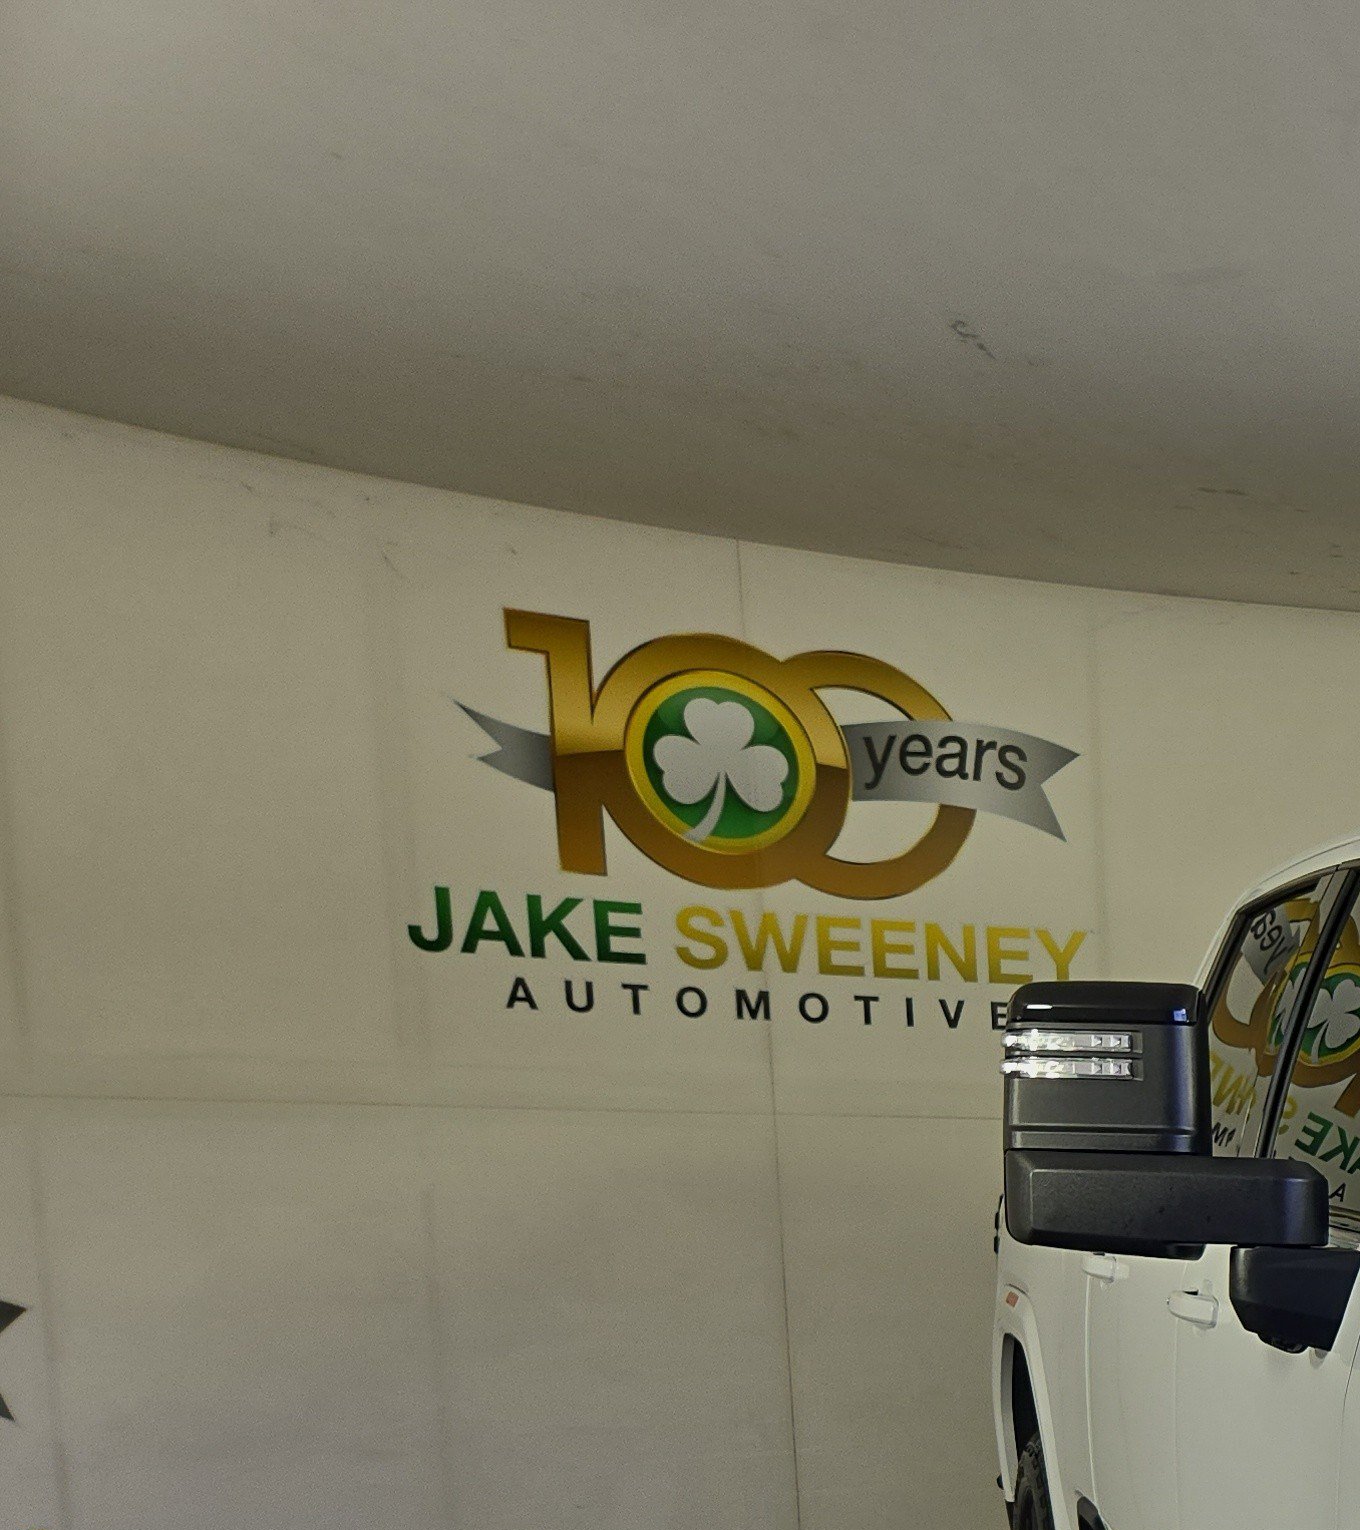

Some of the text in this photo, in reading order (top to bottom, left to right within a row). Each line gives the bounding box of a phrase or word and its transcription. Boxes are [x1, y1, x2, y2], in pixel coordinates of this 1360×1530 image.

[862, 732, 1028, 791] years
[408, 886, 1087, 985] JAKE SWEENEY
